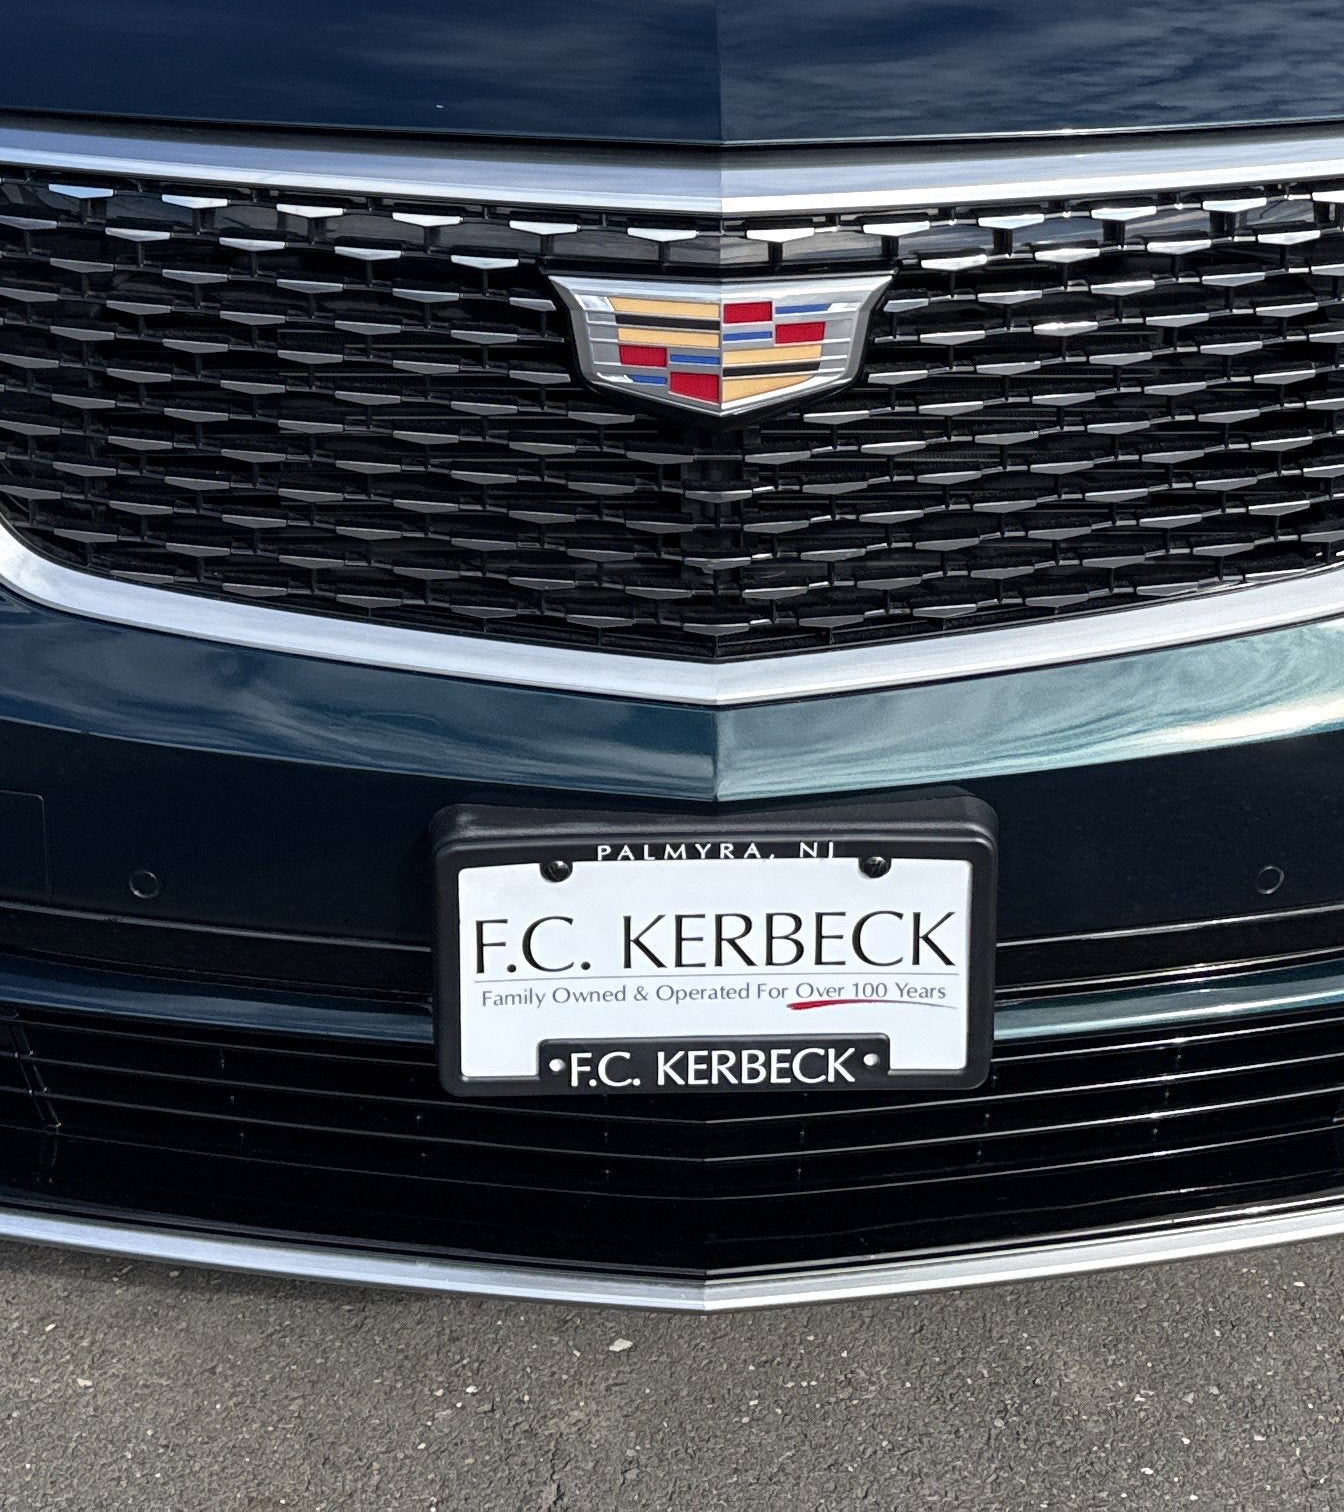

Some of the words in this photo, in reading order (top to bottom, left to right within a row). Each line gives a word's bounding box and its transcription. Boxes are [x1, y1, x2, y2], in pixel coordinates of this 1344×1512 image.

[597, 842, 774, 861] PALMYRA,
[475, 915, 591, 975] F.C.
[623, 910, 956, 970] KERBECK
[482, 987, 546, 1009] Family
[552, 985, 627, 1004] Owned
[634, 985, 649, 1002] &
[656, 982, 750, 1005] Operated
[757, 982, 789, 1000] For
[795, 982, 845, 999] Over
[853, 982, 888, 999] 100
[895, 982, 947, 1000] Years
[570, 1051, 641, 1087] F.C.
[657, 1048, 855, 1086] KERBECK
